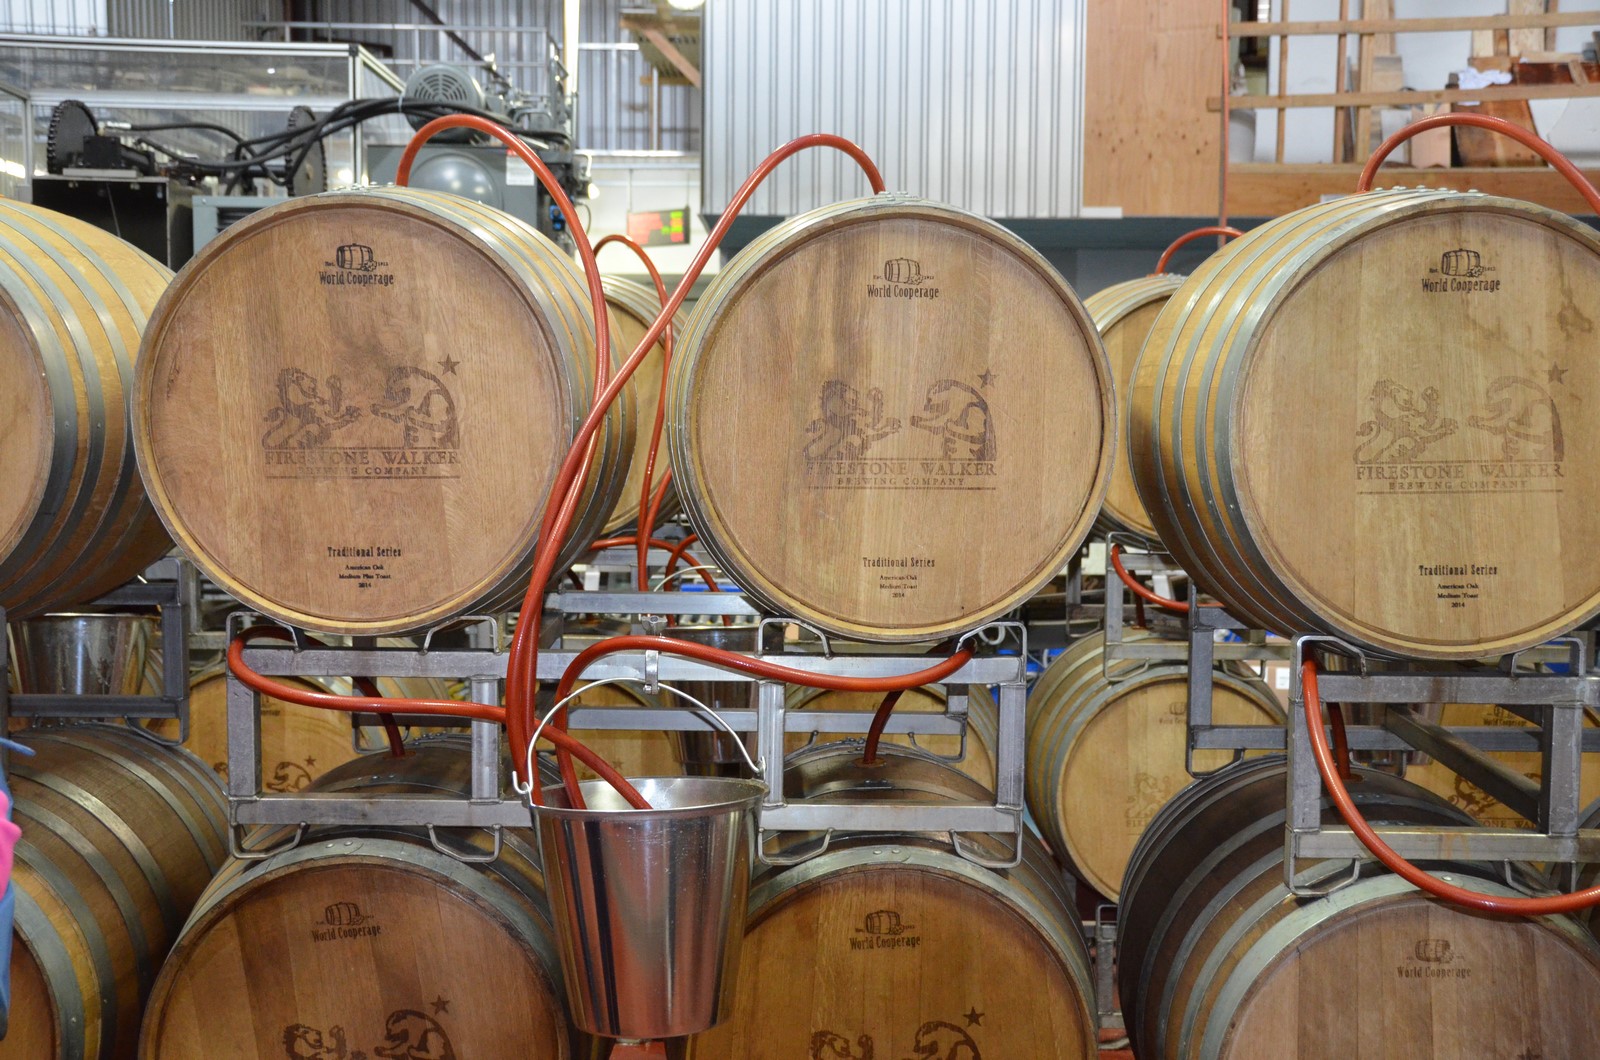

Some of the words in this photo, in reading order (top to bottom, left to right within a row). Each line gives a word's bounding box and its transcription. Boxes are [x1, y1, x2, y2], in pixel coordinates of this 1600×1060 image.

[319, 271, 344, 285] World
[347, 271, 394, 287] Cooperage
[1421, 278, 1447, 292] World
[1450, 278, 1500, 293] Cooperage
[866, 284, 891, 298] World
[893, 284, 939, 299] Cooperage
[265, 451, 370, 465] FIRESTONE
[382, 451, 460, 465] WALKER
[365, 466, 428, 475] COMPANY
[806, 462, 907, 476] FIRESTONE
[921, 462, 997, 476] WALKER
[1356, 464, 1464, 480] FIRESTONE
[1480, 463, 1564, 478] WALKER
[837, 477, 897, 486] BREWING
[903, 477, 965, 486] COMPANY
[1389, 481, 1452, 490] BREWING
[1460, 480, 1528, 489] COMPANY
[327, 546, 374, 557] Traditional
[376, 546, 401, 557] Series
[862, 556, 908, 567] Traditional
[910, 556, 935, 567] Series
[1418, 565, 1467, 576] Traditional
[1471, 564, 1497, 576] Series
[311, 928, 336, 942] World
[337, 925, 381, 939] Cooperage
[849, 936, 874, 950] World
[876, 936, 921, 949] Cooperage
[1397, 966, 1422, 978] World
[1425, 966, 1471, 979] Cooperage
